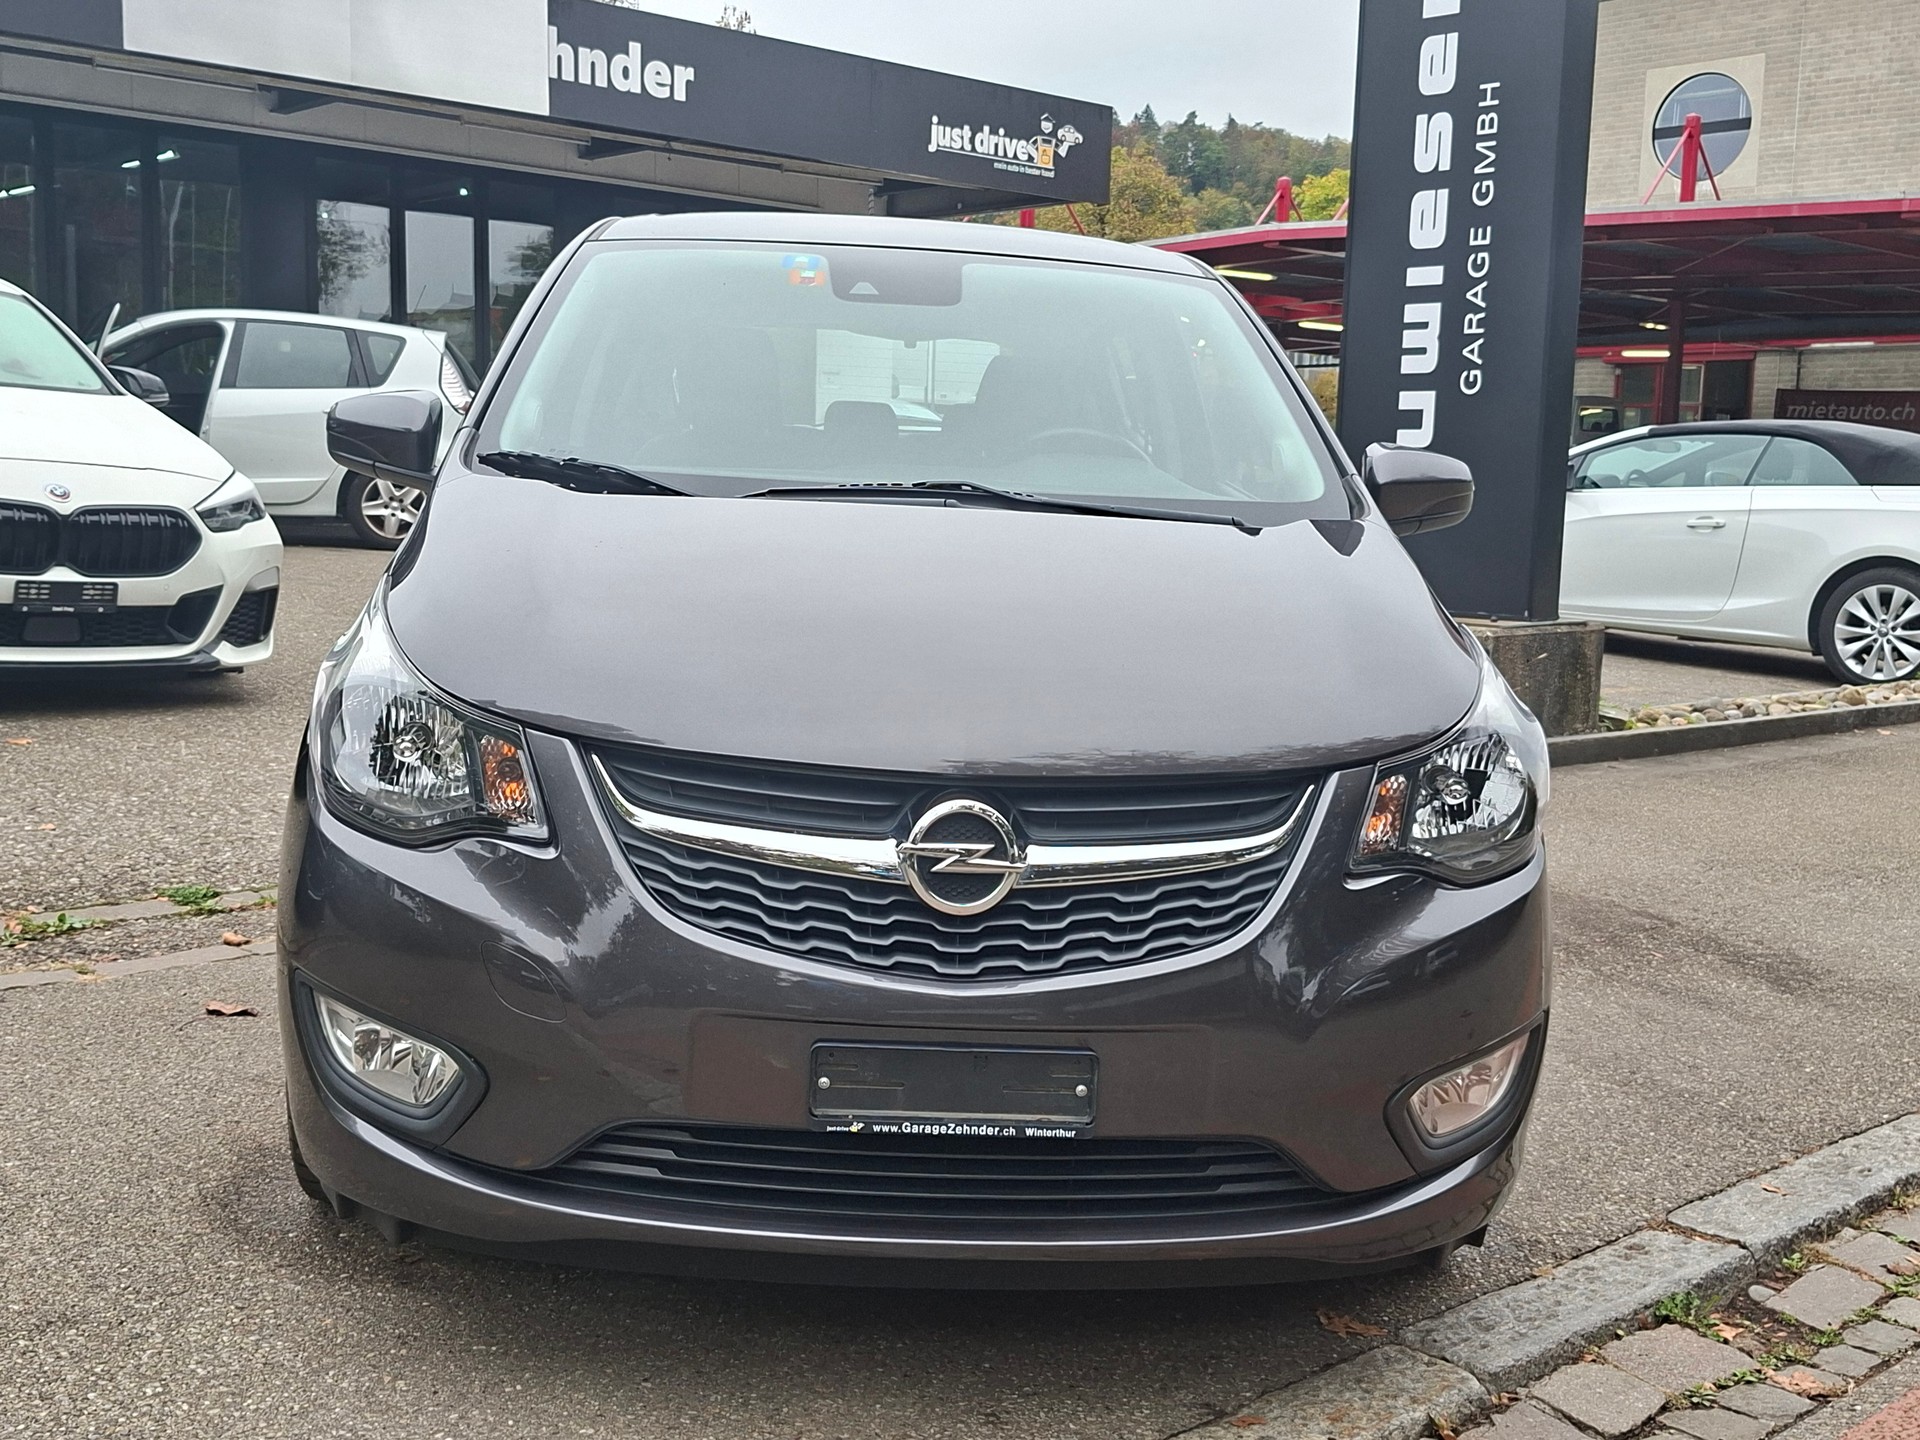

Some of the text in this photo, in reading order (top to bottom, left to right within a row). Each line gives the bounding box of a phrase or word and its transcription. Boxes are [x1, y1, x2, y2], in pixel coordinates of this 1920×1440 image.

[548, 24, 695, 102] hnder
[928, 115, 1029, 161] just drive
[1459, 82, 1501, 395] GARAGE GMBH
[1786, 401, 1916, 420] mietauto.ch
[872, 1121, 1016, 1137] www.GarageZehnder.ch
[1024, 1127, 1077, 1138] Winterthur
